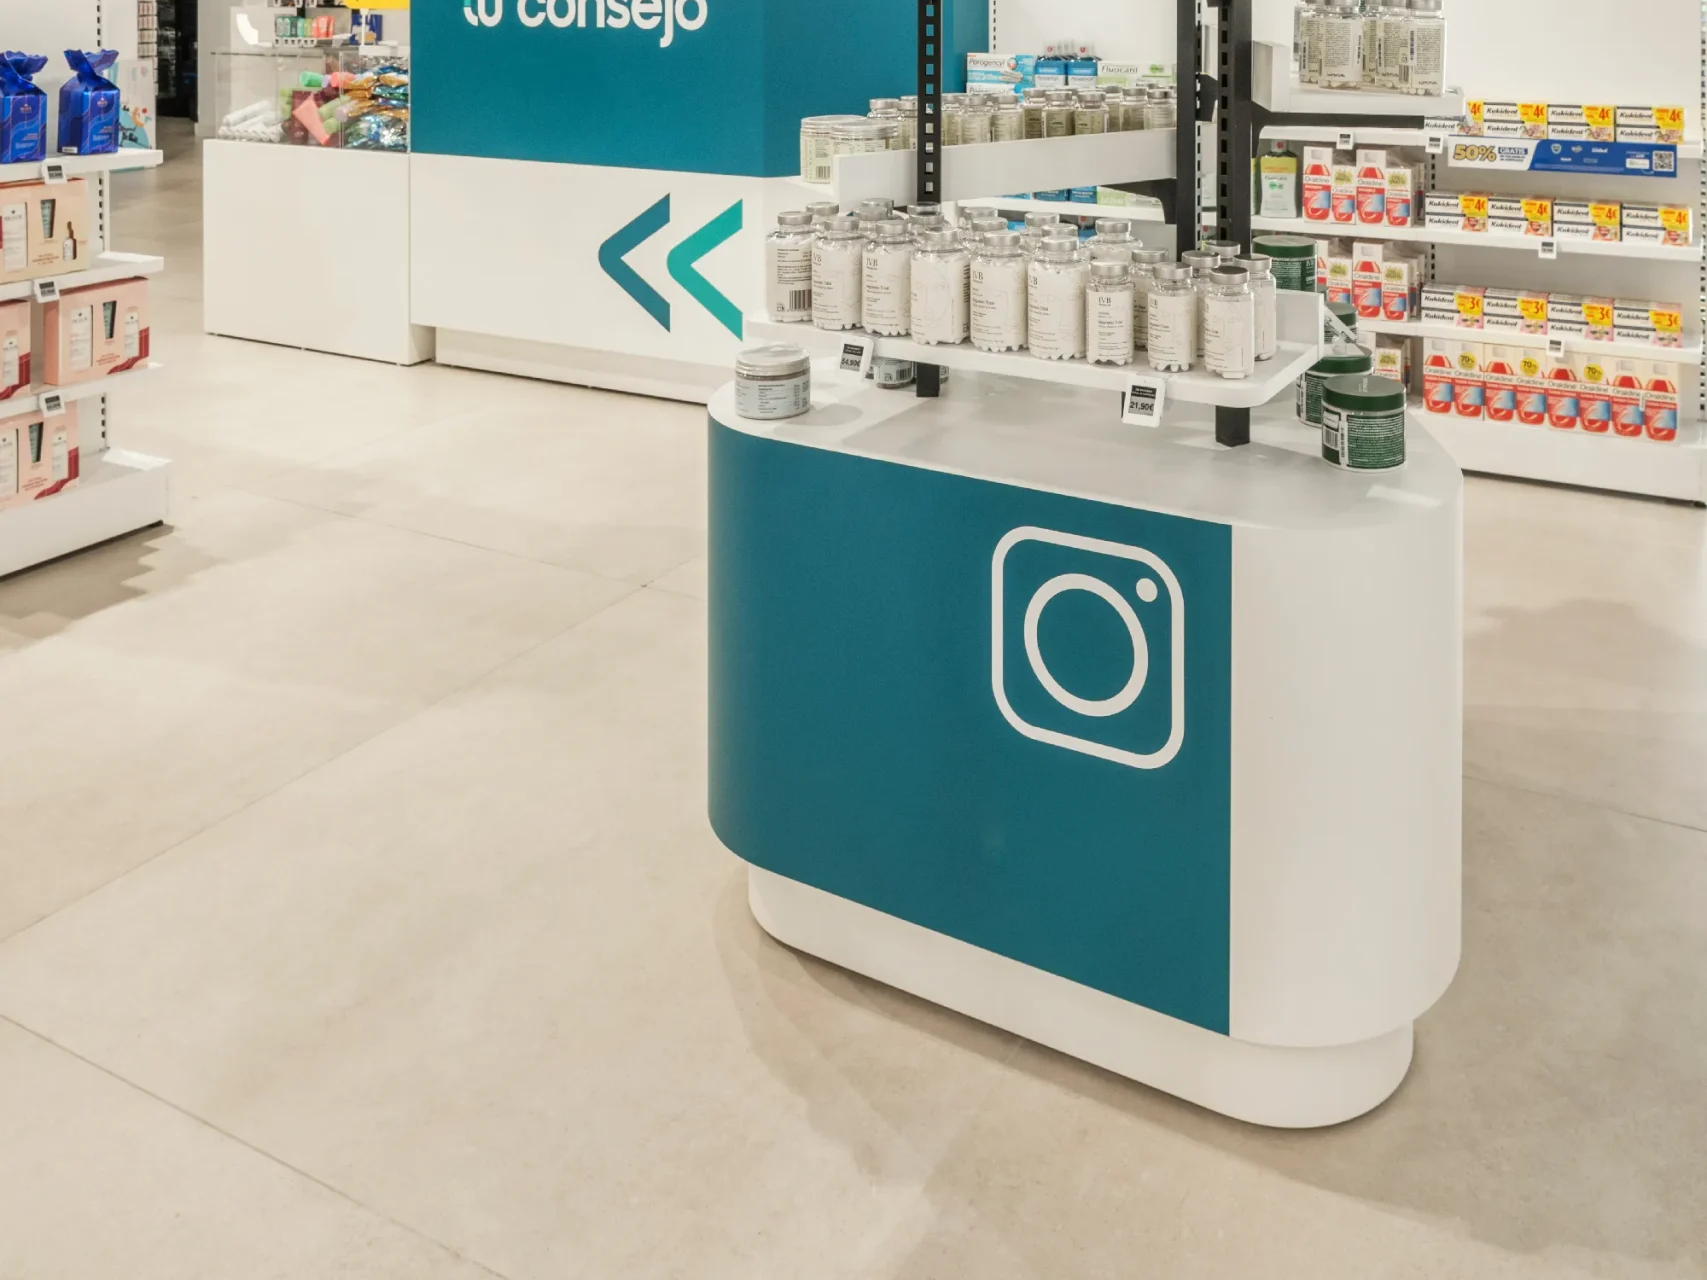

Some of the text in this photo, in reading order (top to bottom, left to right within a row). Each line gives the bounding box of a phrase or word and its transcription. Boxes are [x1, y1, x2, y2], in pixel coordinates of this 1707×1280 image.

[969, 57, 1005, 69] Parogencyl
[1533, 105, 1544, 118] 4€
[1599, 107, 1610, 120] 4€
[1487, 125, 1518, 133] Kukident
[1453, 143, 1497, 162] 50%
[1428, 199, 1486, 212] Kukident 4€
[1537, 203, 1548, 216] 4€
[1557, 209, 1589, 217] Kukident
[866, 257, 878, 267] IVB
[1098, 296, 1111, 304] IVB
[1424, 295, 1481, 310] Kukident 3€
[1486, 301, 1544, 314] Kukident 3€
[1551, 307, 1582, 315] Kukident
[1424, 313, 1454, 321] Kukident
[1486, 319, 1518, 327] Kukident
[1551, 324, 1582, 332] Kukident
[1617, 331, 1649, 339] Kukident
[1129, 401, 1154, 412] 21,90€
